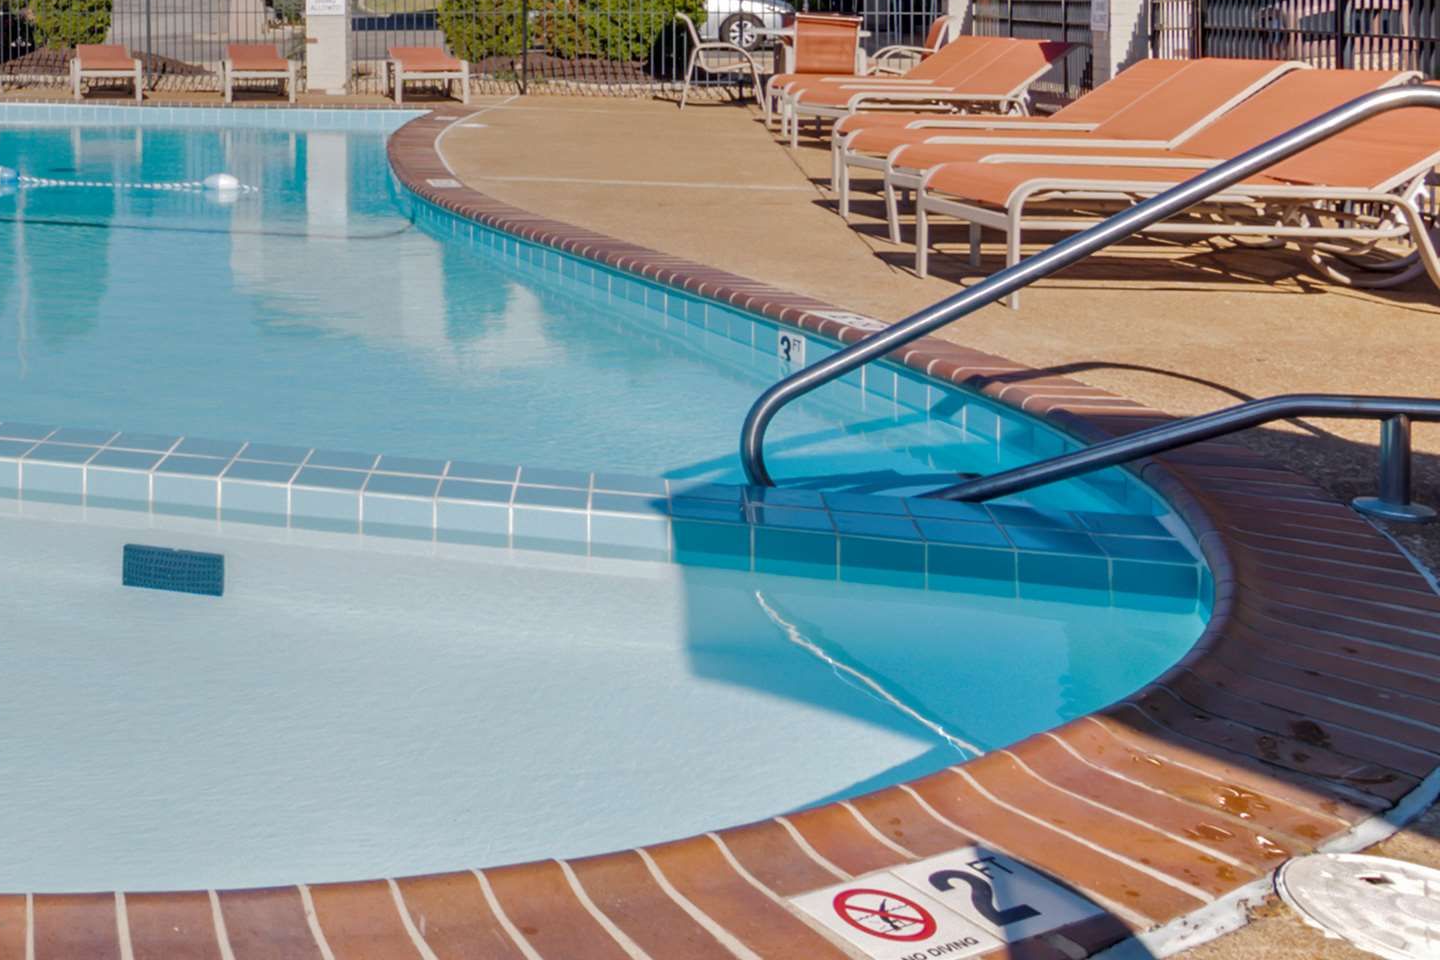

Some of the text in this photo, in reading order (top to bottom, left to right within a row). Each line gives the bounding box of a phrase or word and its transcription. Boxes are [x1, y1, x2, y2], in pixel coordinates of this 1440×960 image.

[792, 338, 801, 352] FT
[928, 856, 1041, 927] 2 FT
[927, 936, 979, 957] DIVING
